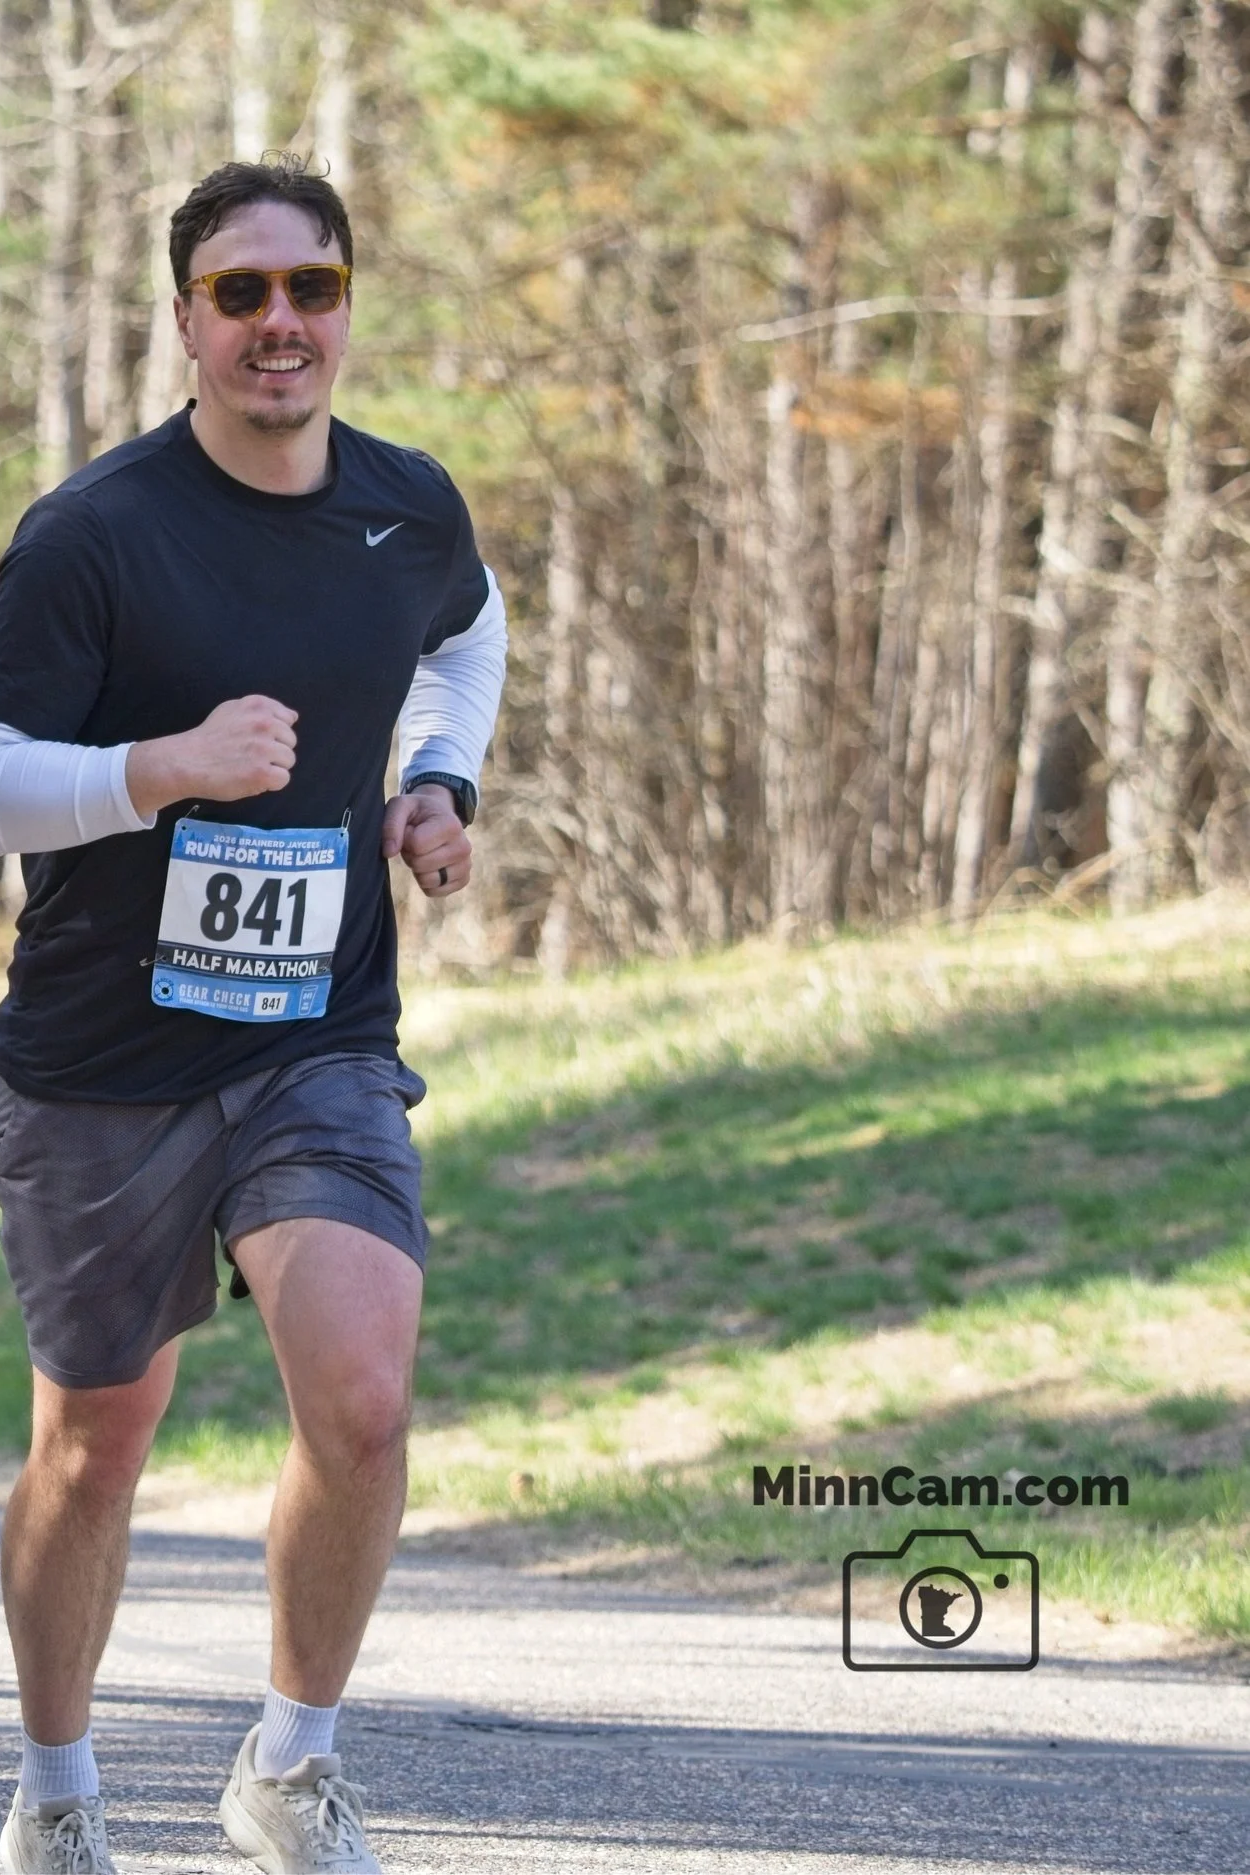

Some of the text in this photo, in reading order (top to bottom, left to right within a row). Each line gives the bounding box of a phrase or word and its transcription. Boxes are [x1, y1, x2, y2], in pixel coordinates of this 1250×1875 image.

[184, 840, 335, 866] RUN FOR THE LAKES
[238, 838, 286, 849] BRAINERD
[200, 872, 308, 946] 841
[172, 949, 319, 978] HALF MARATHON
[178, 983, 209, 1001] GEAR
[213, 989, 251, 1007] CHECK
[261, 997, 282, 1011] 841
